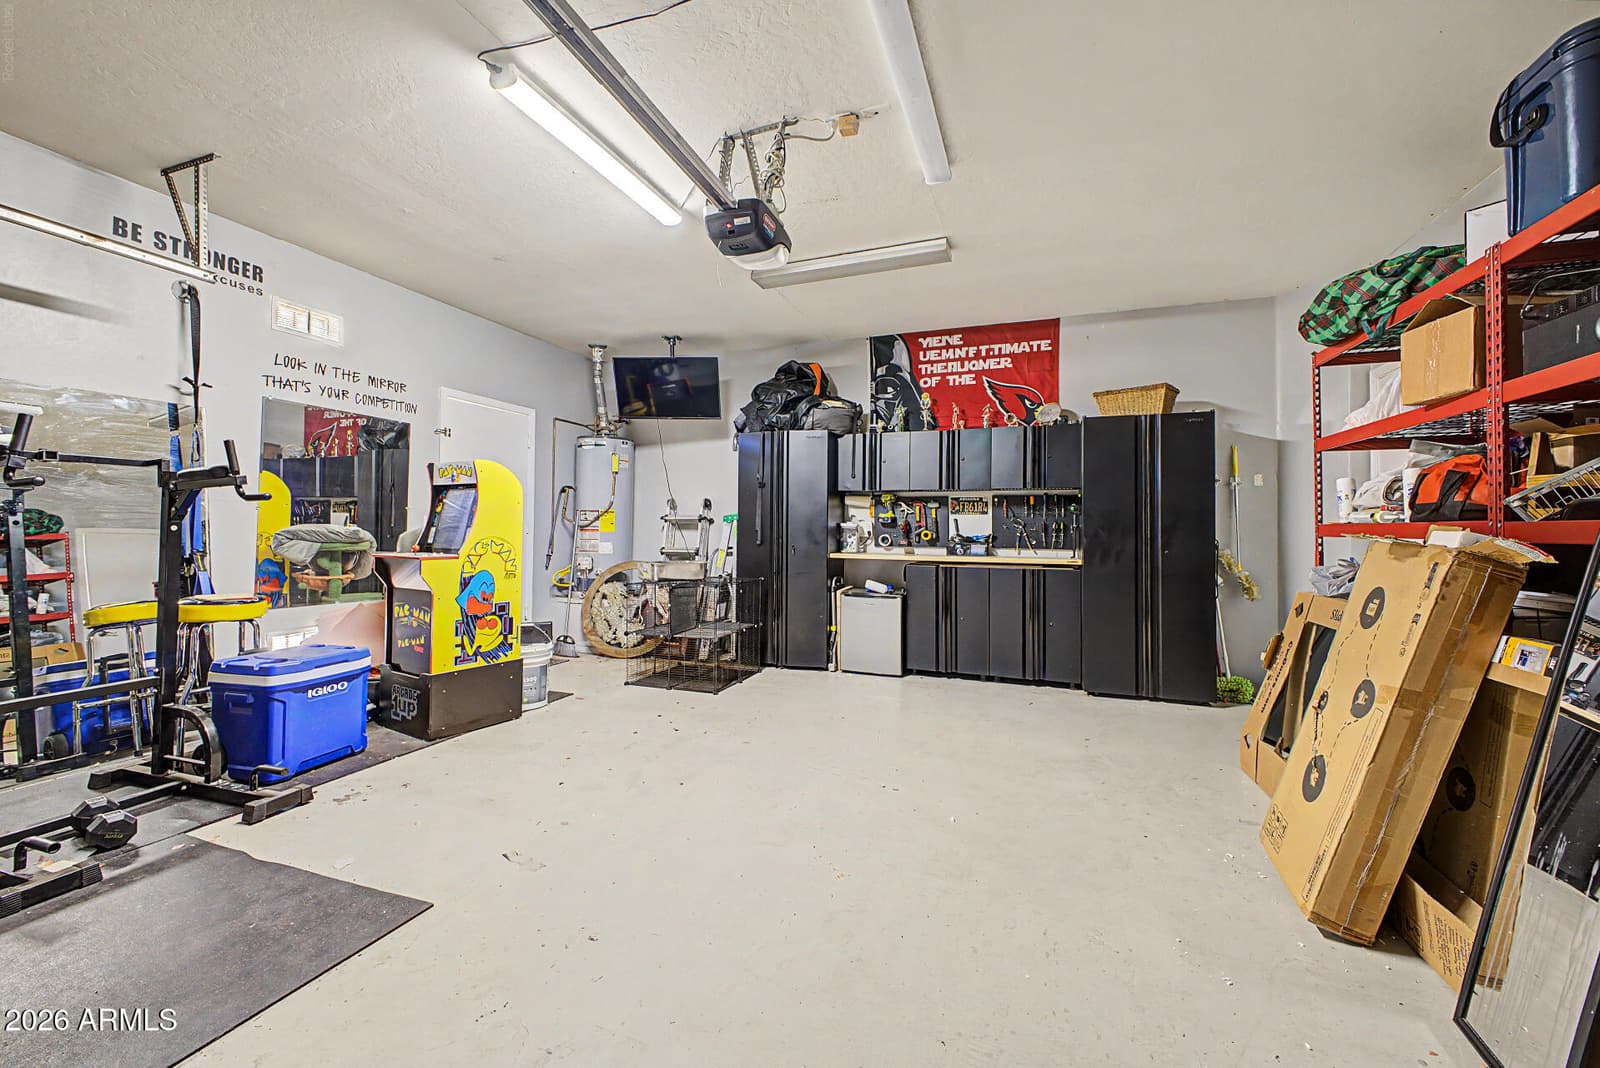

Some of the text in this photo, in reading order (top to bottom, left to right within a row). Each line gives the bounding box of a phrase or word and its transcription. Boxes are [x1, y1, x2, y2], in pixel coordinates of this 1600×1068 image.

[112, 216, 142, 243] BE
[274, 353, 407, 393] LOOK IN THE MIRROR
[919, 374, 977, 388] OF THE
[262, 375, 418, 414] THAT'S YOUR COMPETITION
[307, 680, 348, 698] IGLOO
